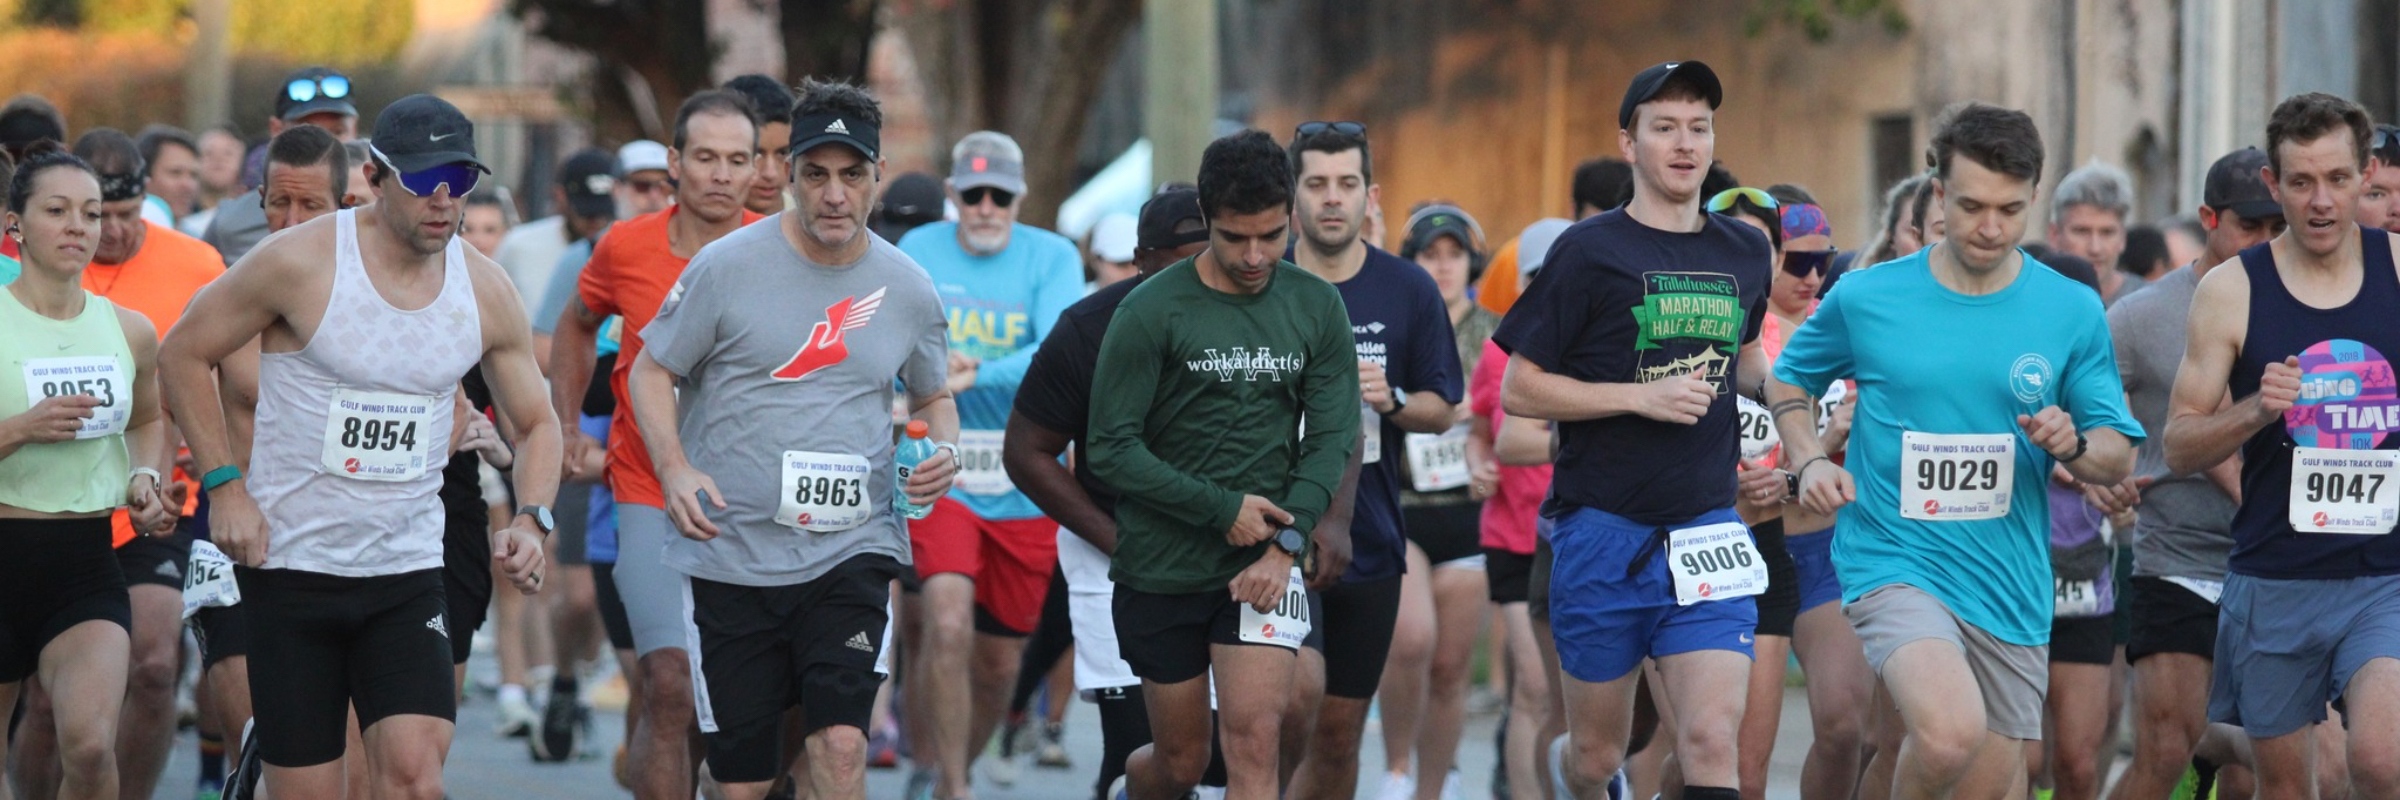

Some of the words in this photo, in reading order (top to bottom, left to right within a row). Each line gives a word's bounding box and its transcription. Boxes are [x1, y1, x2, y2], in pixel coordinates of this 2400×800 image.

[1651, 275, 1733, 295] Tallahassee
[1660, 296, 1733, 318] MARATHON
[949, 307, 1028, 346] HALF
[1653, 318, 1684, 336] HALF
[1684, 318, 1695, 334] &
[1699, 319, 1734, 338] RELAY
[2338, 351, 2358, 362] 2018
[32, 368, 48, 376] GULF
[50, 367, 72, 375] WINDS
[74, 365, 96, 374] TRACK
[98, 364, 114, 372] CLUB
[340, 400, 360, 410] GULF
[362, 403, 384, 413] WINDS
[387, 405, 408, 414] TRACK
[410, 406, 426, 414] CLUB
[341, 416, 417, 452] 8954
[1740, 411, 1770, 440] 26
[1912, 443, 1930, 452] GULF
[1933, 444, 1958, 453] WINDS
[1961, 445, 1985, 453] TRACK
[1988, 444, 2006, 453] CLUB
[2352, 438, 2372, 450] 10K
[791, 462, 808, 470] GULF
[810, 463, 832, 471] WINDS
[834, 464, 853, 472] TRACK
[855, 465, 867, 473] CLUB
[959, 449, 1003, 471] 007
[2302, 458, 2320, 466] GULF
[2323, 459, 2347, 467] WINDS
[2350, 460, 2373, 468] TRACK
[2375, 460, 2394, 468] CLUB
[898, 466, 909, 478] G
[1917, 458, 1998, 491] 9029
[796, 476, 861, 507] 8963
[2306, 472, 2385, 504] 9047
[1672, 539, 1686, 548] GULF
[1688, 536, 1708, 546] WINDS
[1708, 532, 1730, 542] TRACK
[1680, 542, 1752, 576] 9006
[185, 559, 226, 590] 052
[2056, 580, 2083, 602] 45
[1252, 590, 1307, 623] 000
[845, 640, 874, 653] adidas
